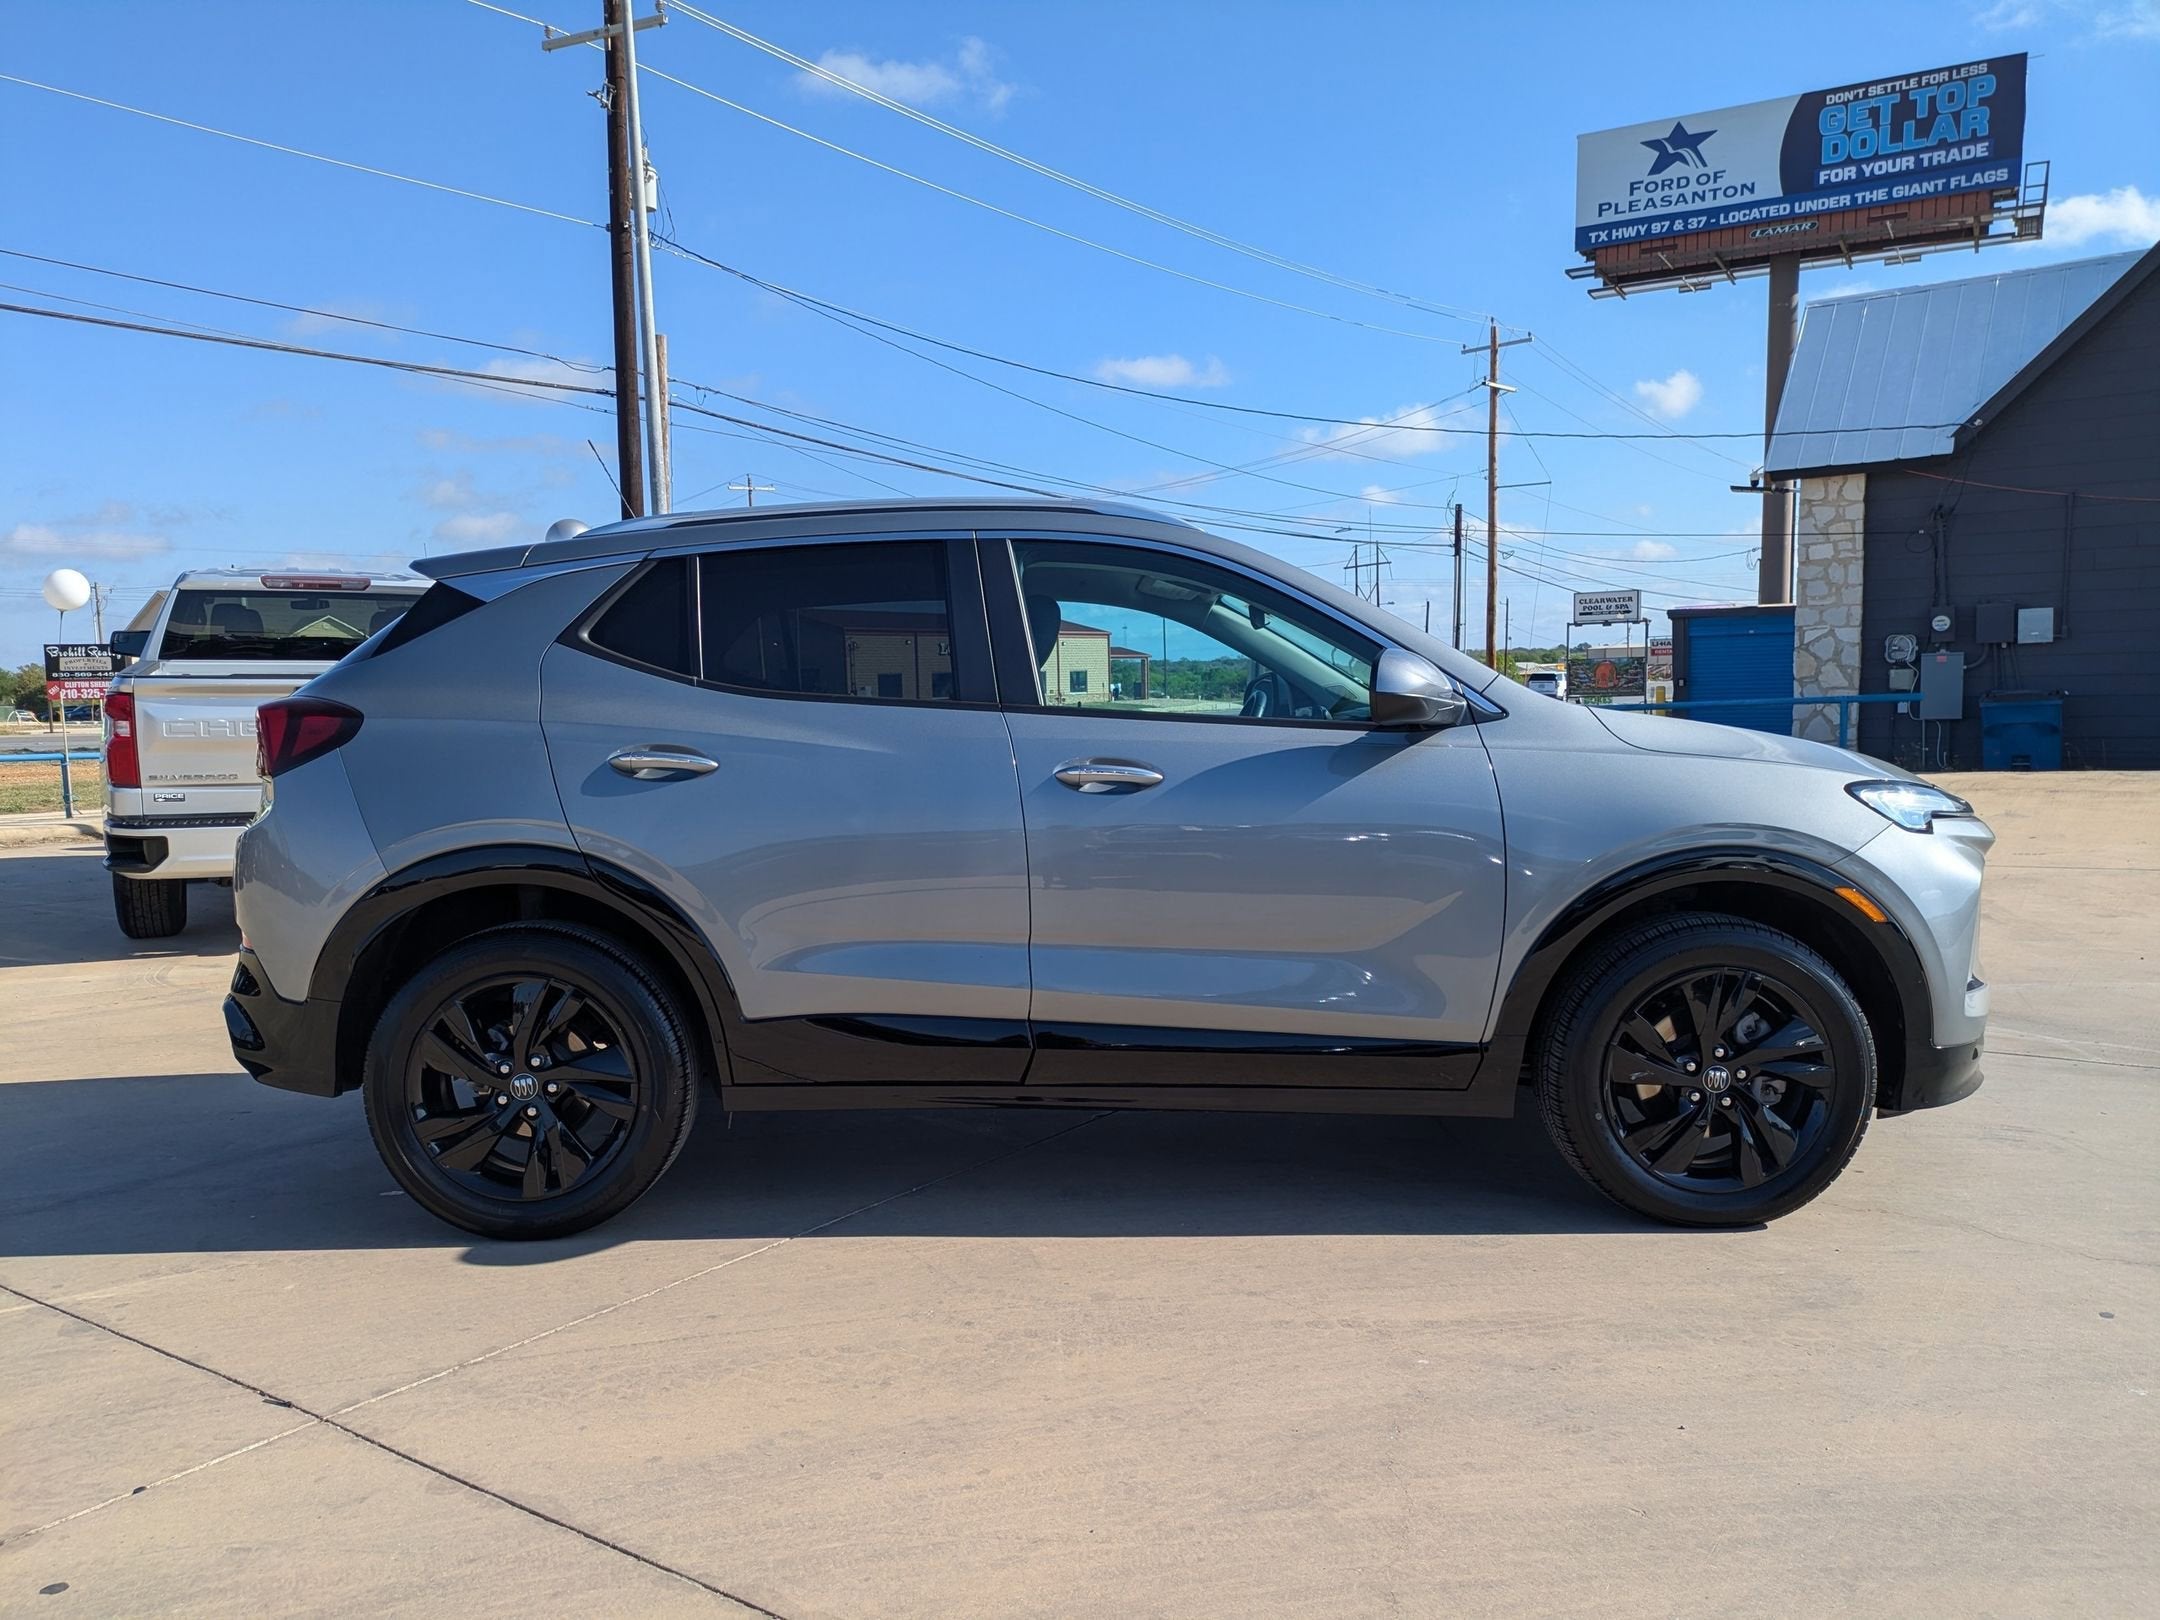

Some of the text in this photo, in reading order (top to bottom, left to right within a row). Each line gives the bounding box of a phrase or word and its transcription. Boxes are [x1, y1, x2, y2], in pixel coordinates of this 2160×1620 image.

[1826, 62, 1988, 106] DON'T SETTLE FOR LESS
[1819, 74, 1997, 136] GET TOP
[1821, 106, 1991, 165] DOLLAR
[1819, 142, 1989, 185] FOR YOUR TRADE
[1597, 182, 1756, 218] PLEASANTON
[1629, 169, 1727, 196] FORD OF
[1589, 229, 1609, 244] TX
[1611, 223, 1648, 241] HWY
[1651, 220, 1671, 235] 97
[1673, 219, 1685, 231] &
[1687, 215, 1708, 230] 37
[1719, 203, 1790, 225] LOCATED
[1794, 193, 1851, 214] UNDER
[1854, 187, 1889, 206] THE
[1892, 178, 1946, 199] GIANT
[1950, 168, 2009, 190] FLAGS
[1755, 222, 1812, 238] LAMAR
[1579, 596, 1633, 605] CLEARWATER
[87, 646, 122, 660] Realy
[60, 688, 108, 699] 210-325-7
